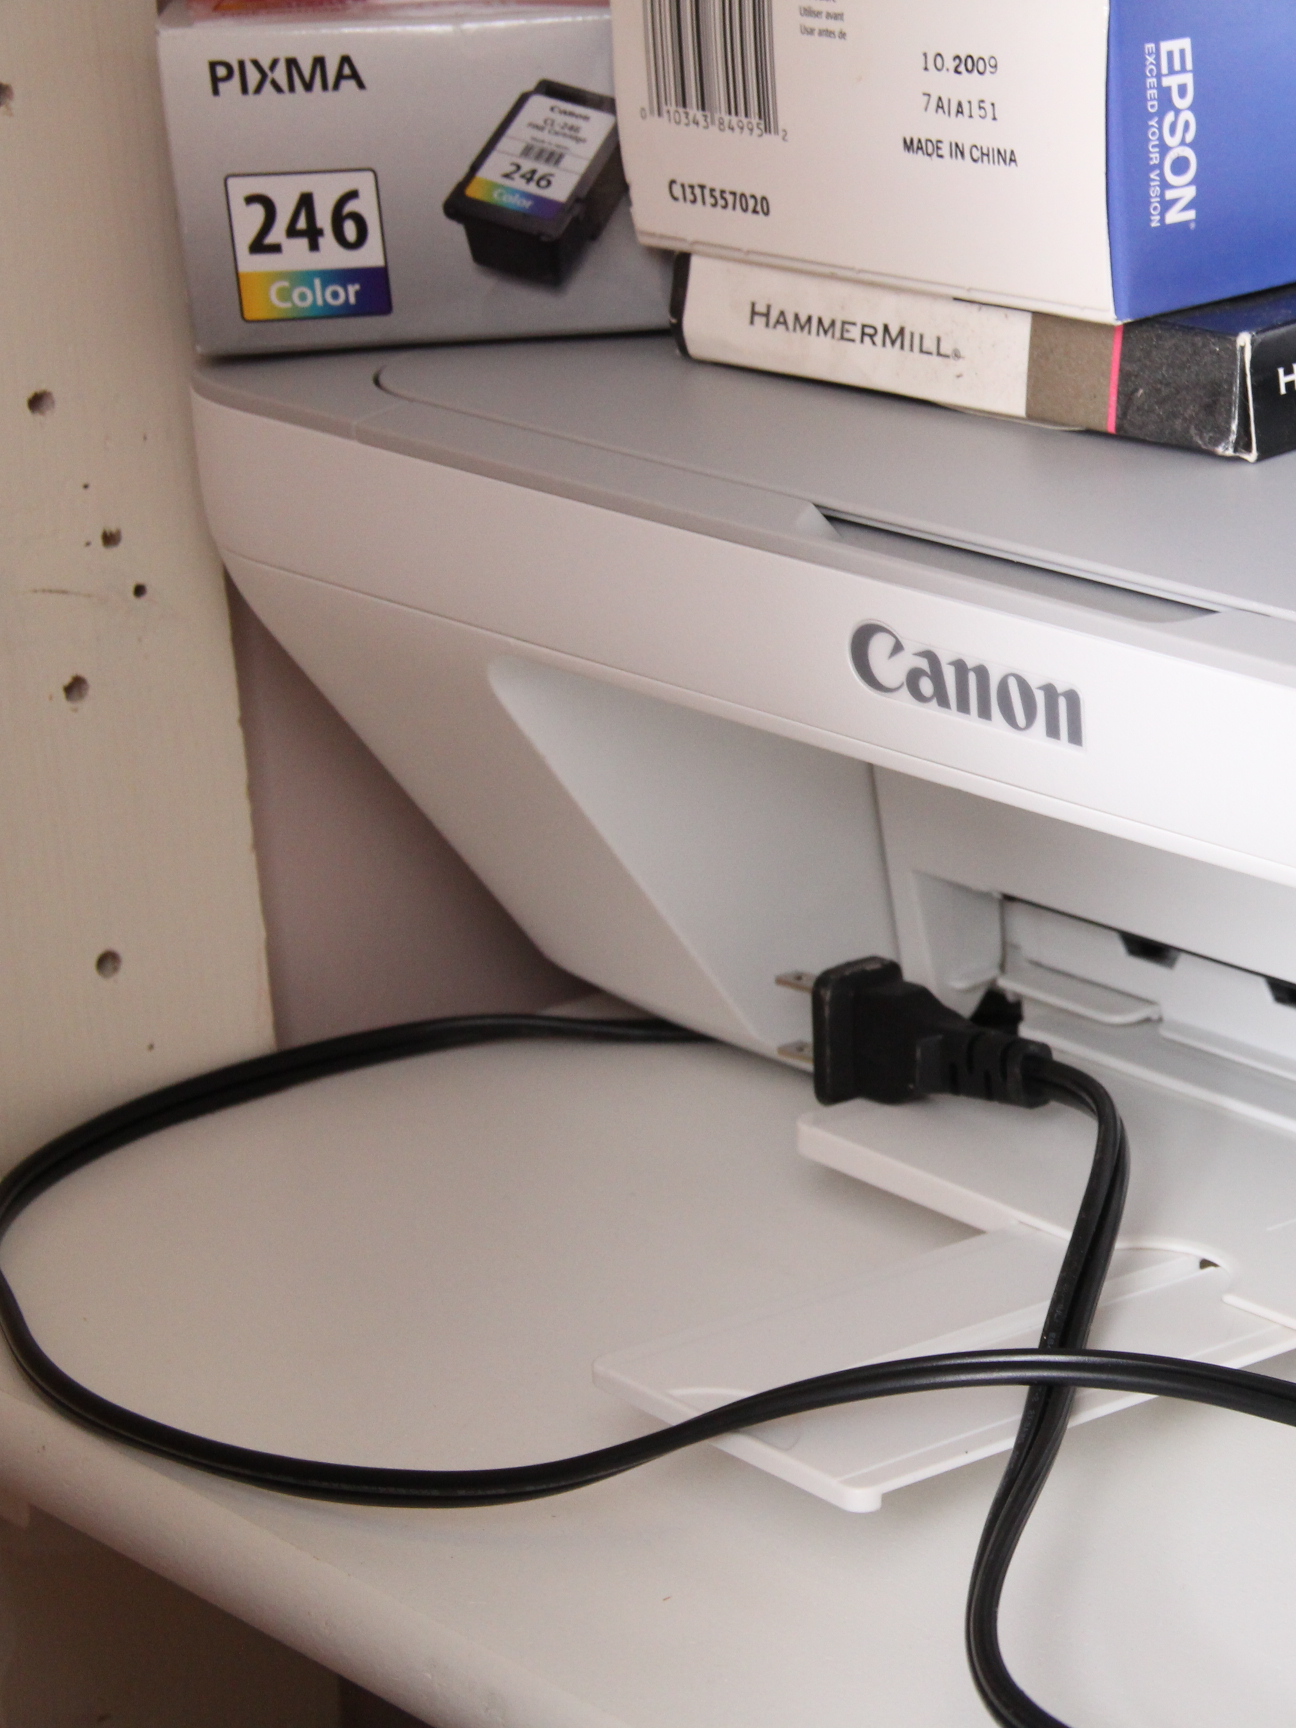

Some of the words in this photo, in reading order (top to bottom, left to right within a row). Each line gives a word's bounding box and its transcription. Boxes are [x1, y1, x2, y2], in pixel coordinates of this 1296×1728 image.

[799, 23, 817, 36] Usar
[838, 28, 847, 40] de
[207, 55, 366, 97] PIXMA
[922, 51, 998, 76] 10.2009
[1144, 43, 1158, 113] EXCEED
[666, 109, 710, 130] 10343
[718, 117, 764, 137] 84995
[1148, 117, 1160, 165] YOUR
[1160, 37, 1197, 225] EPSON
[903, 137, 944, 159] MADE
[949, 141, 965, 161] IN
[970, 144, 1018, 167] CHINA
[501, 162, 555, 189] 246
[493, 189, 534, 209] Color
[669, 178, 771, 217] C13T557020
[1149, 170, 1160, 227] VISION
[243, 189, 369, 255] 246
[269, 279, 361, 309] Color
[850, 623, 1083, 747] Canon
